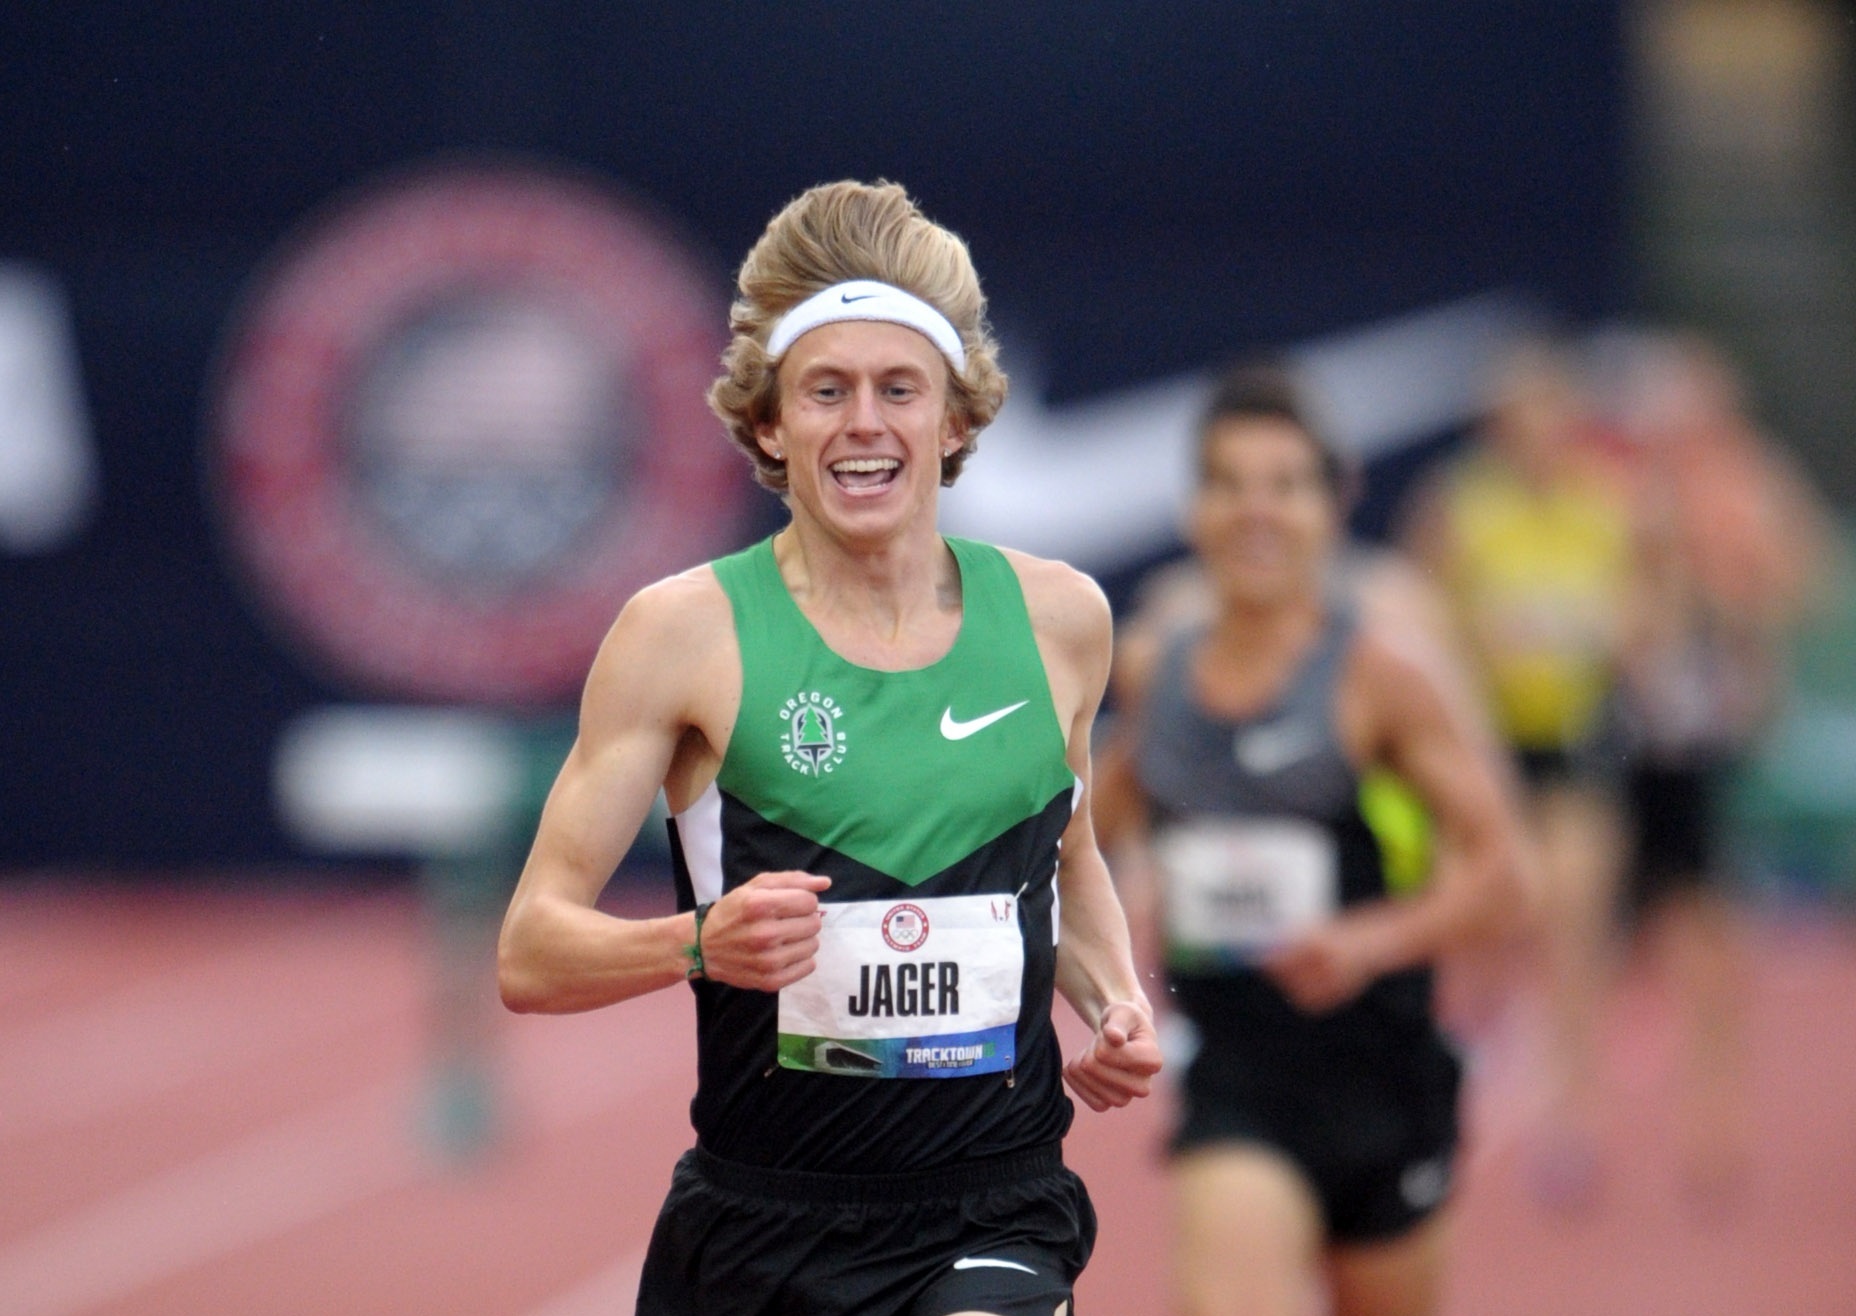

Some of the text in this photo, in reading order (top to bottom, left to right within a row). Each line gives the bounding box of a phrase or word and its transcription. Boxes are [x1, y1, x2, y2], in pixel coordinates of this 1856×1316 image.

[779, 691, 843, 721] OREGON
[780, 731, 847, 775] TRACK CLUB
[848, 961, 960, 1018] JAGER
